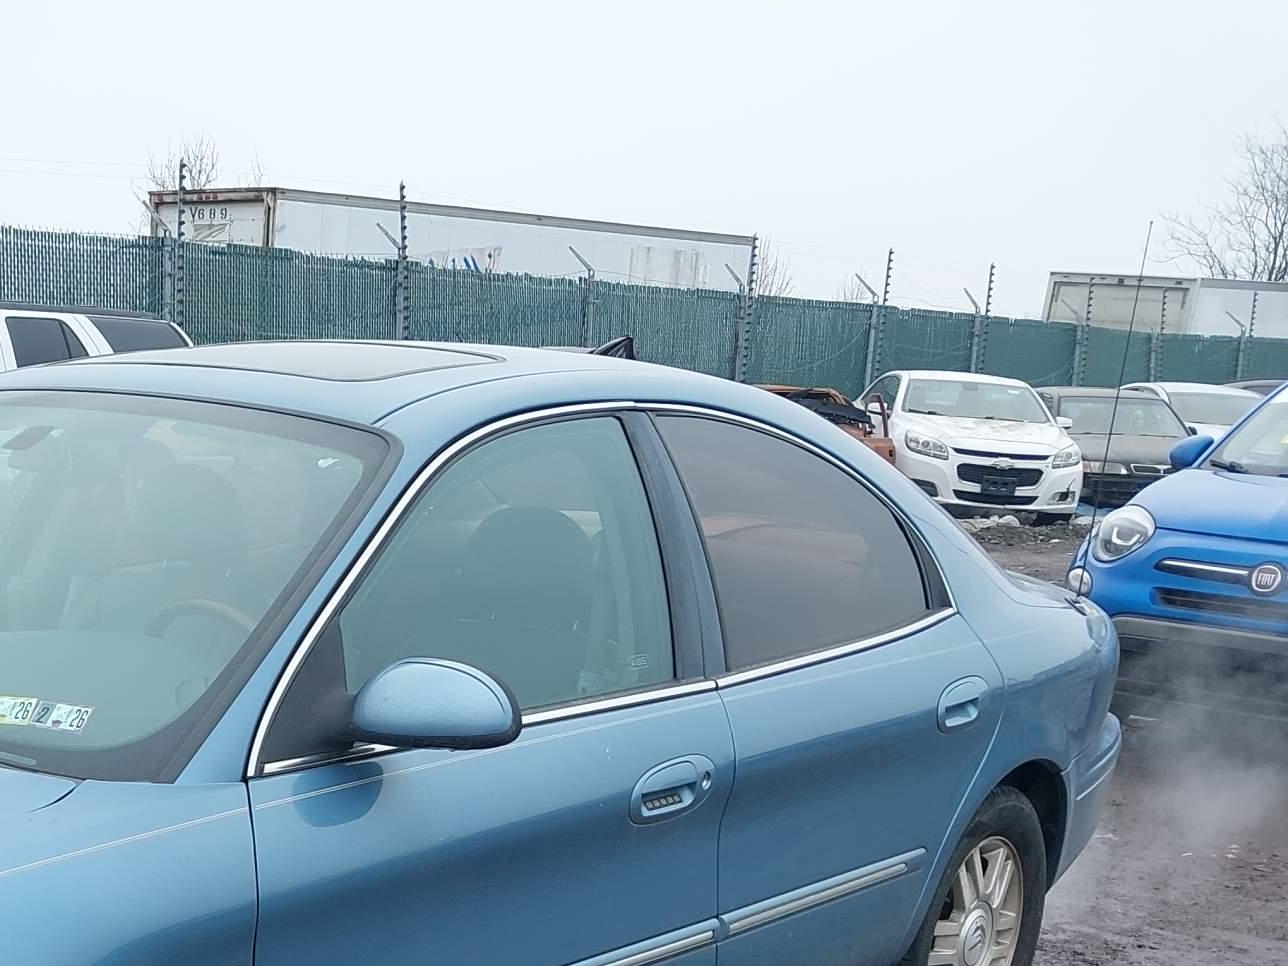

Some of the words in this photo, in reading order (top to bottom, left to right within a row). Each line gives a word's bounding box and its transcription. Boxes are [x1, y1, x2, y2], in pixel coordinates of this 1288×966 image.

[1256, 572, 1276, 586] FIAT
[14, 701, 33, 720] 26
[35, 706, 50, 723] 2
[69, 708, 89, 729] 26
